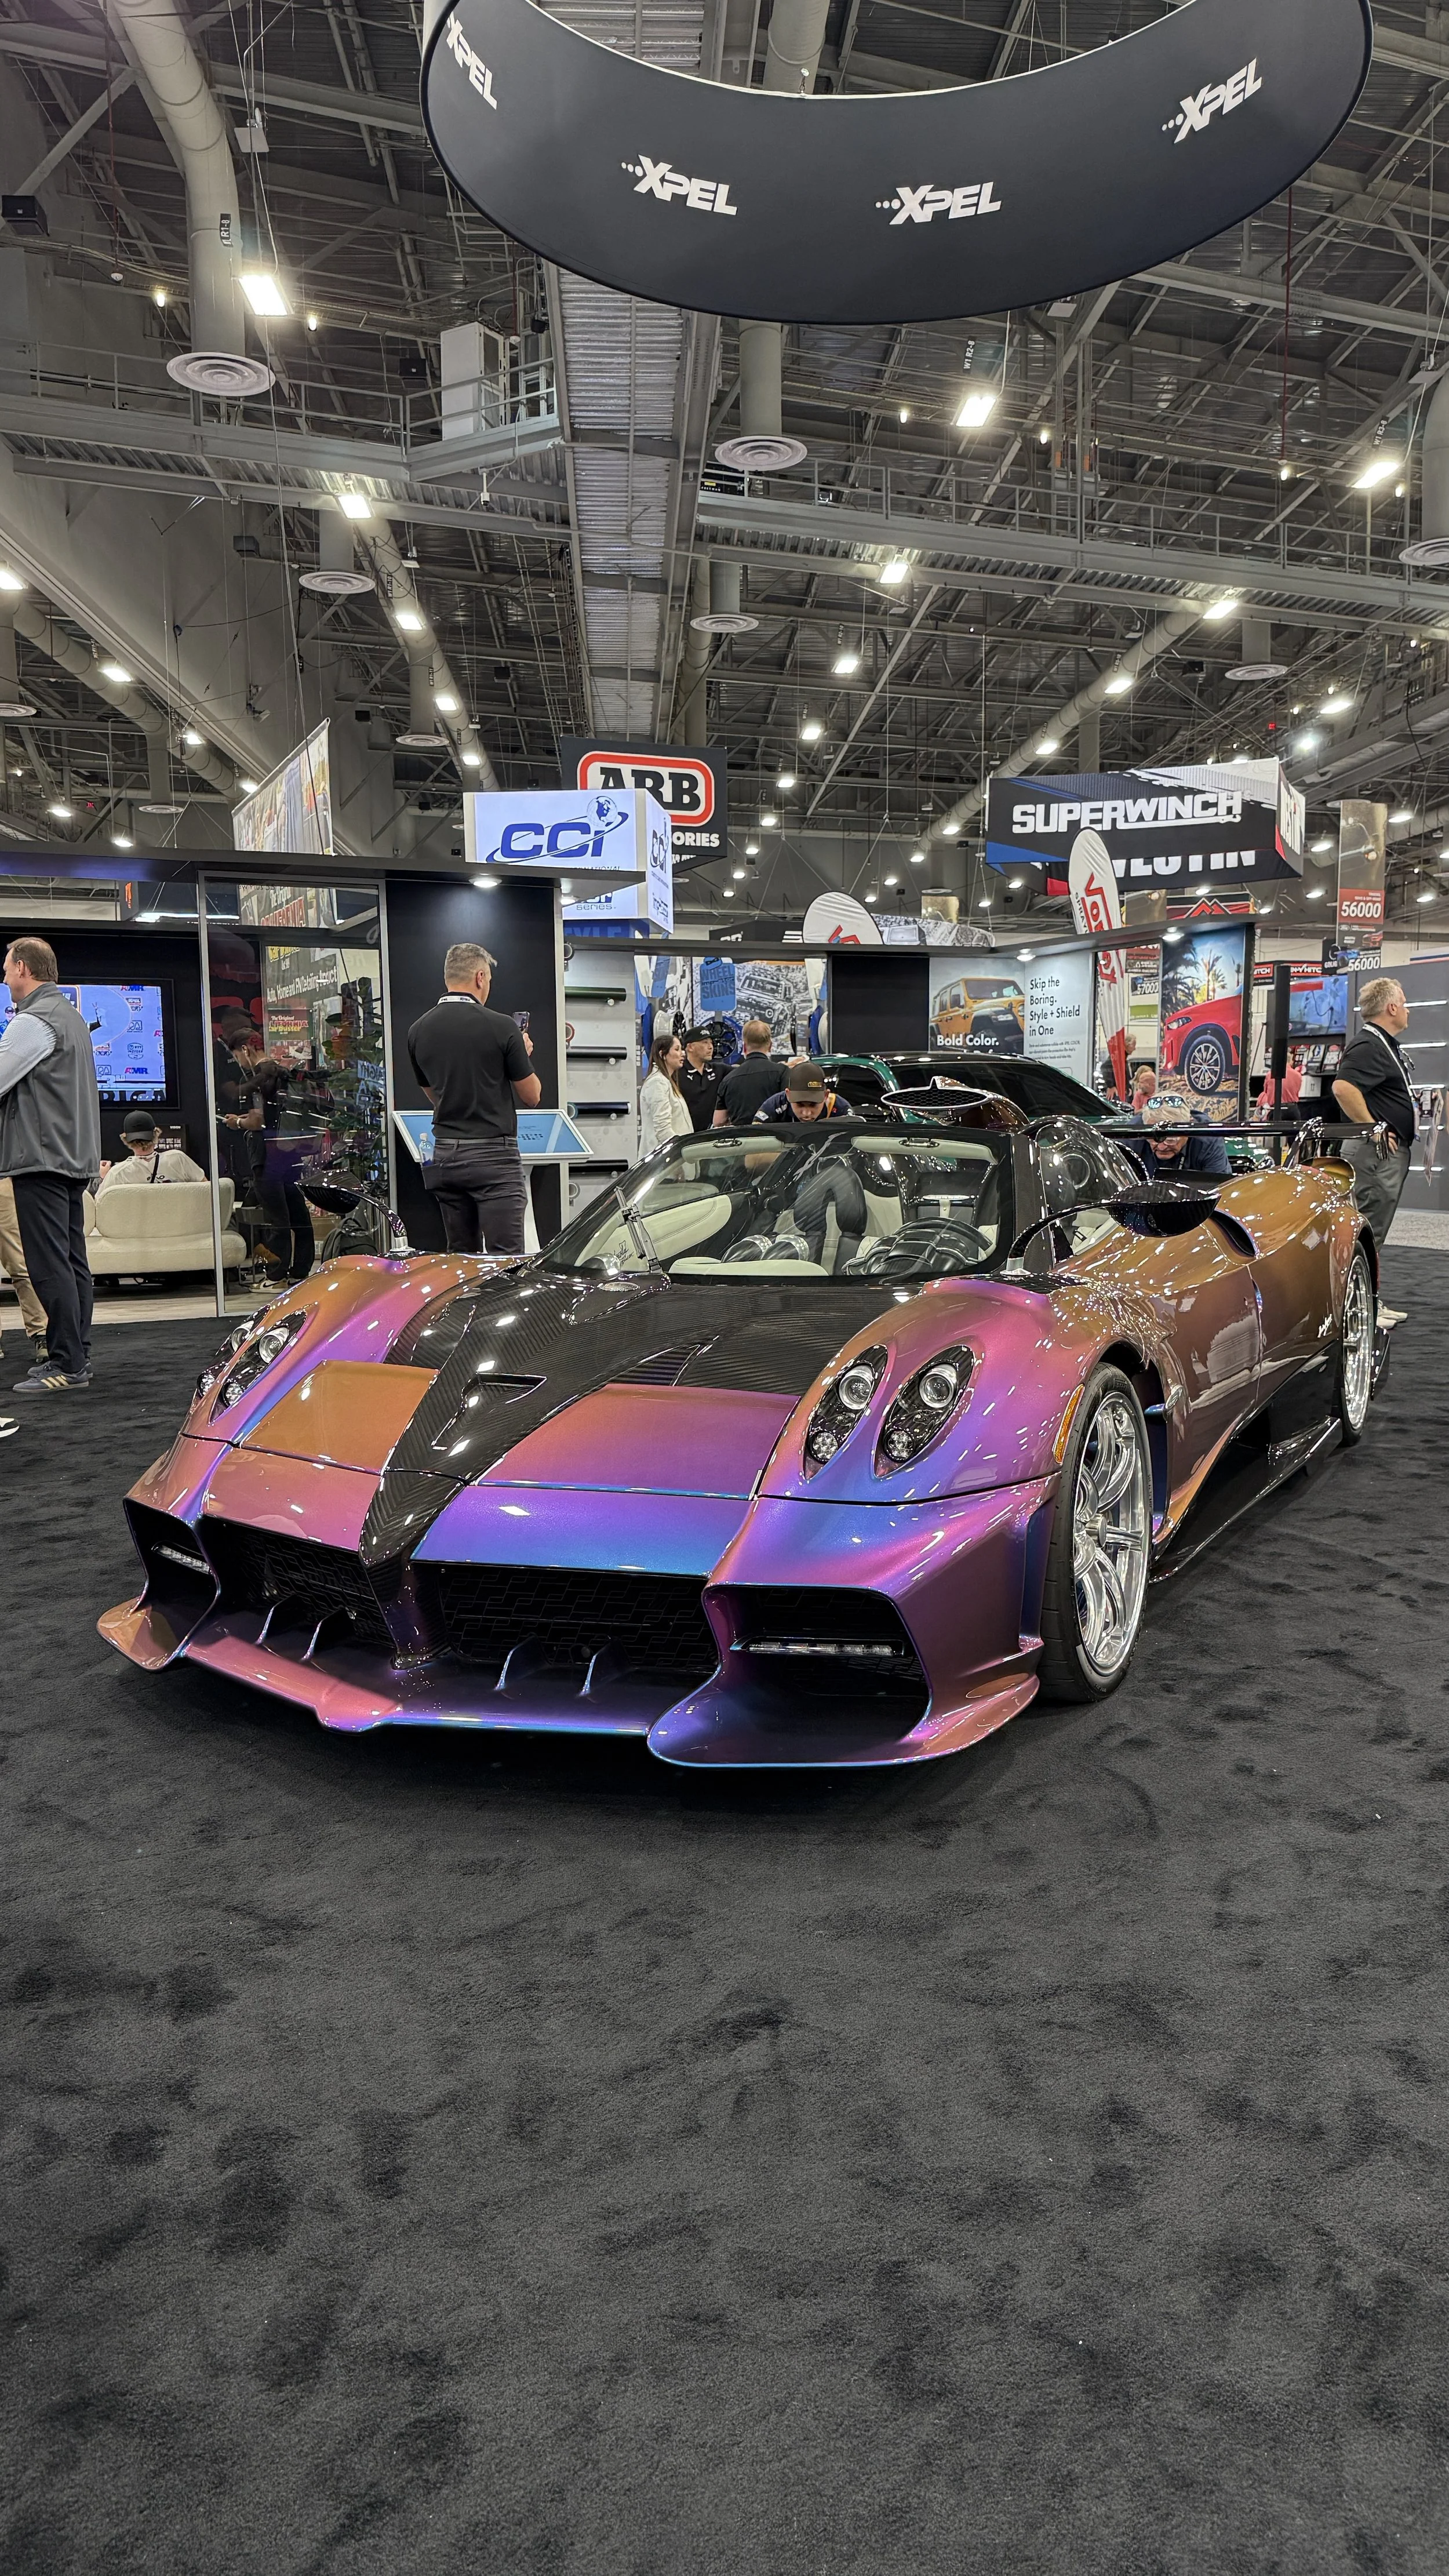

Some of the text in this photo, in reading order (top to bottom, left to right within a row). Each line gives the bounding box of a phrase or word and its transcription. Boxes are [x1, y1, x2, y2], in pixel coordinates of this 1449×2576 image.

[446, 17, 498, 110] XPEL
[1174, 57, 1263, 144] XPEL
[634, 154, 737, 215] XPEL
[889, 181, 1002, 225] XPEL
[221, 220, 230, 237] R1-8
[963, 340, 975, 369] W1 R2-8
[1373, 436, 1382, 445] W1
[600, 766, 701, 812] ARB
[1012, 791, 1242, 834] SUPERWINCH
[672, 831, 720, 847] ORIES
[1341, 901, 1381, 918] 56000
[1348, 956, 1380, 972] 56000
[702, 983, 735, 999] SKINS
[1030, 976, 1060, 991] Skip the
[1030, 994, 1057, 1007] Boring.
[1029, 1010, 1048, 1023] Style
[1056, 1005, 1080, 1018] Shield
[1029, 1025, 1054, 1036] in One
[937, 1034, 999, 1046] Bold Color.
